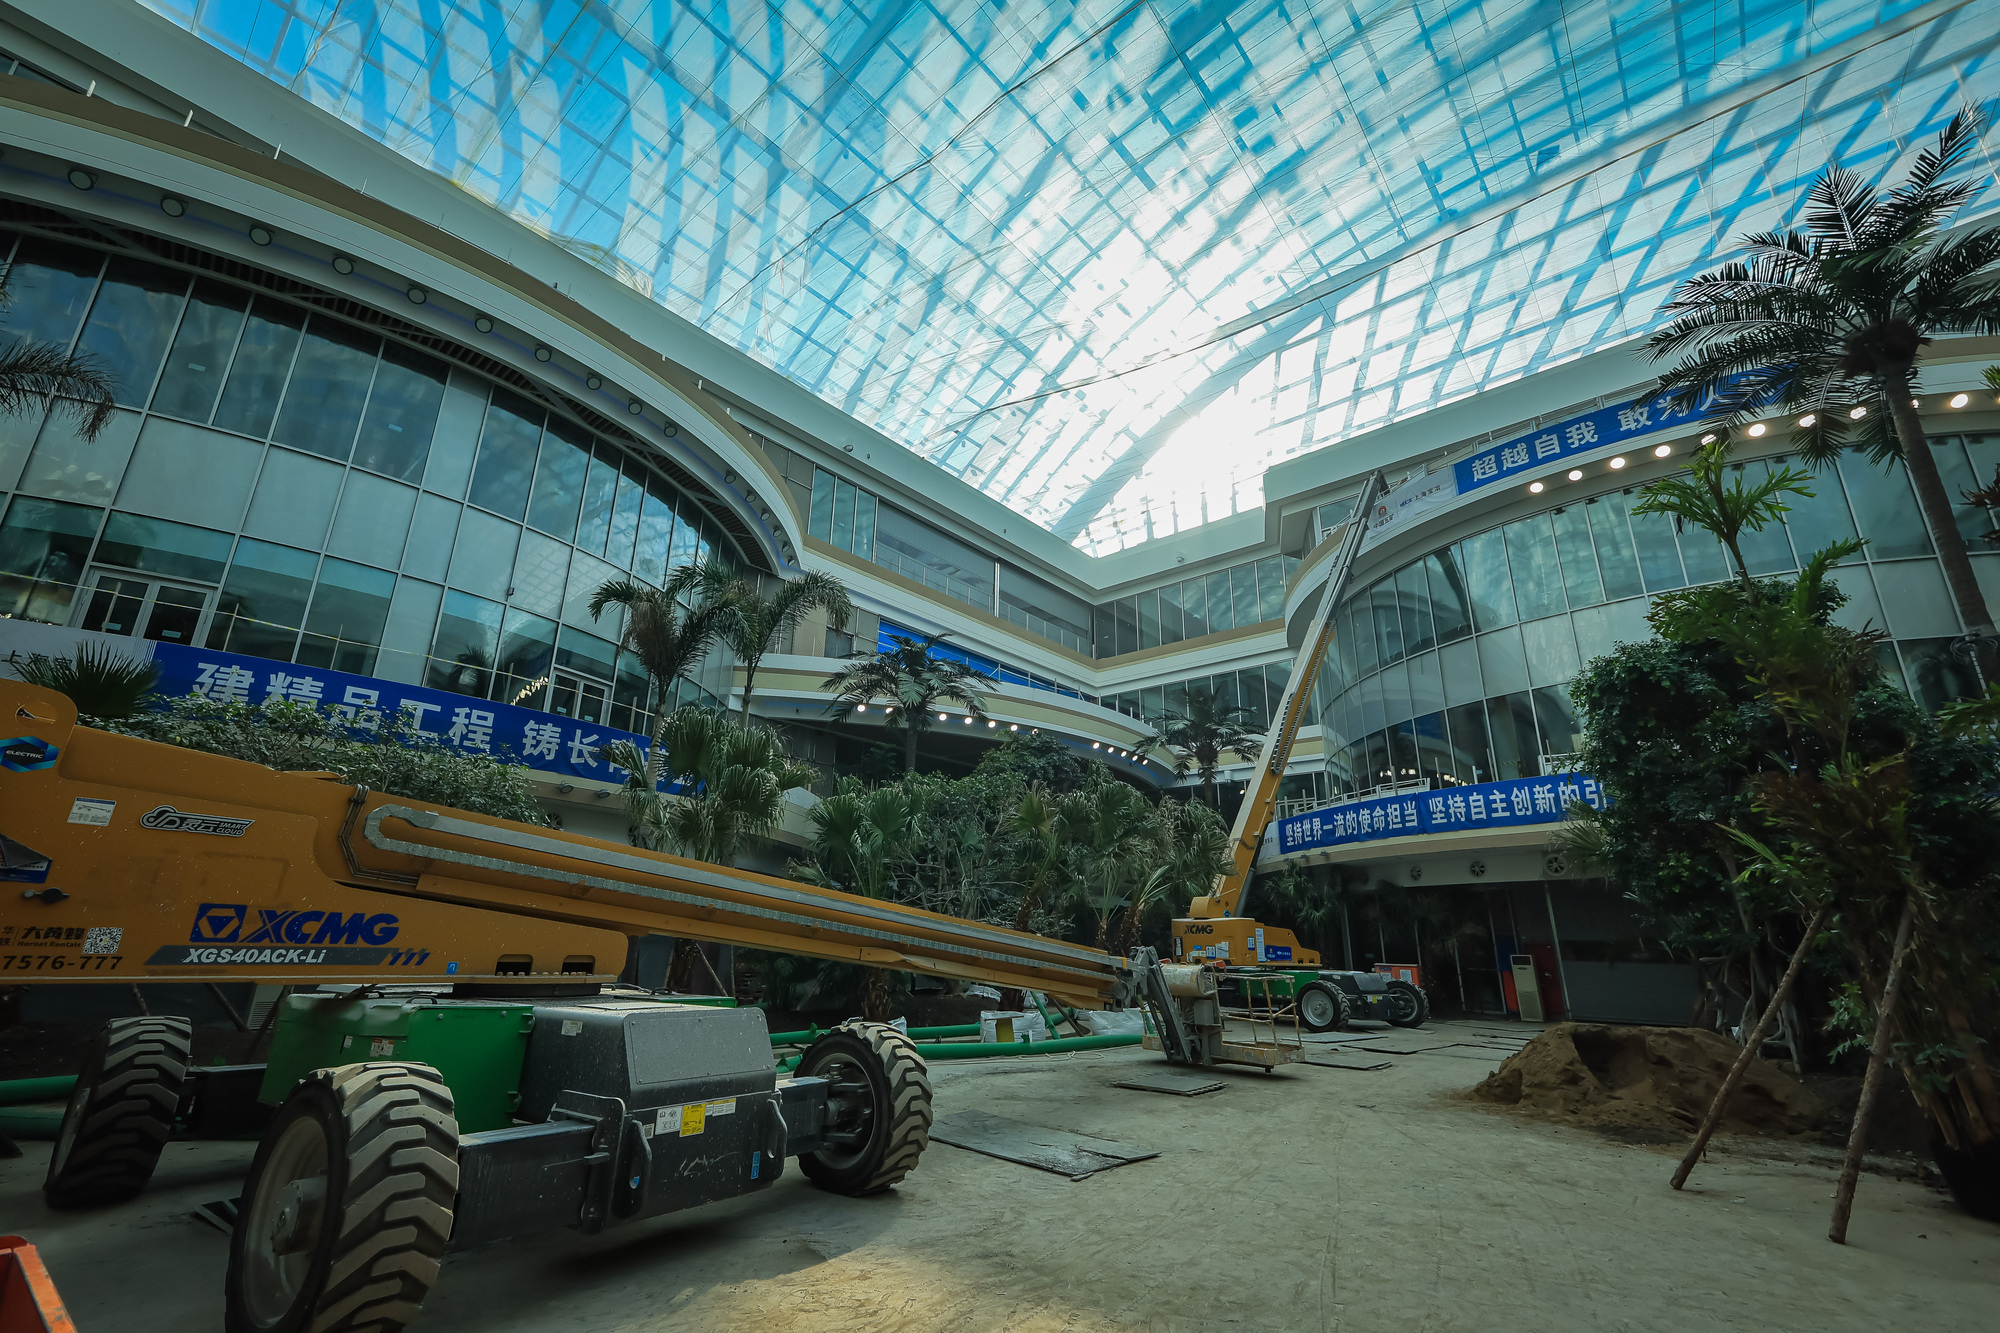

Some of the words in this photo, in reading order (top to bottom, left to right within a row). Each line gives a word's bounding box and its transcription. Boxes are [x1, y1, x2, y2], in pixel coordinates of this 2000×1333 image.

[1471, 420, 1599, 483] 超越自我
[5, 749, 44, 759] ELECTRIC
[218, 822, 246, 830] SMART
[1285, 804, 1419, 847] 坚持世界一流的使命担当
[21, 926, 86, 940] 大黄蜂
[239, 909, 400, 946] XCMG
[181, 947, 327, 965] XGS40ACK-Li
